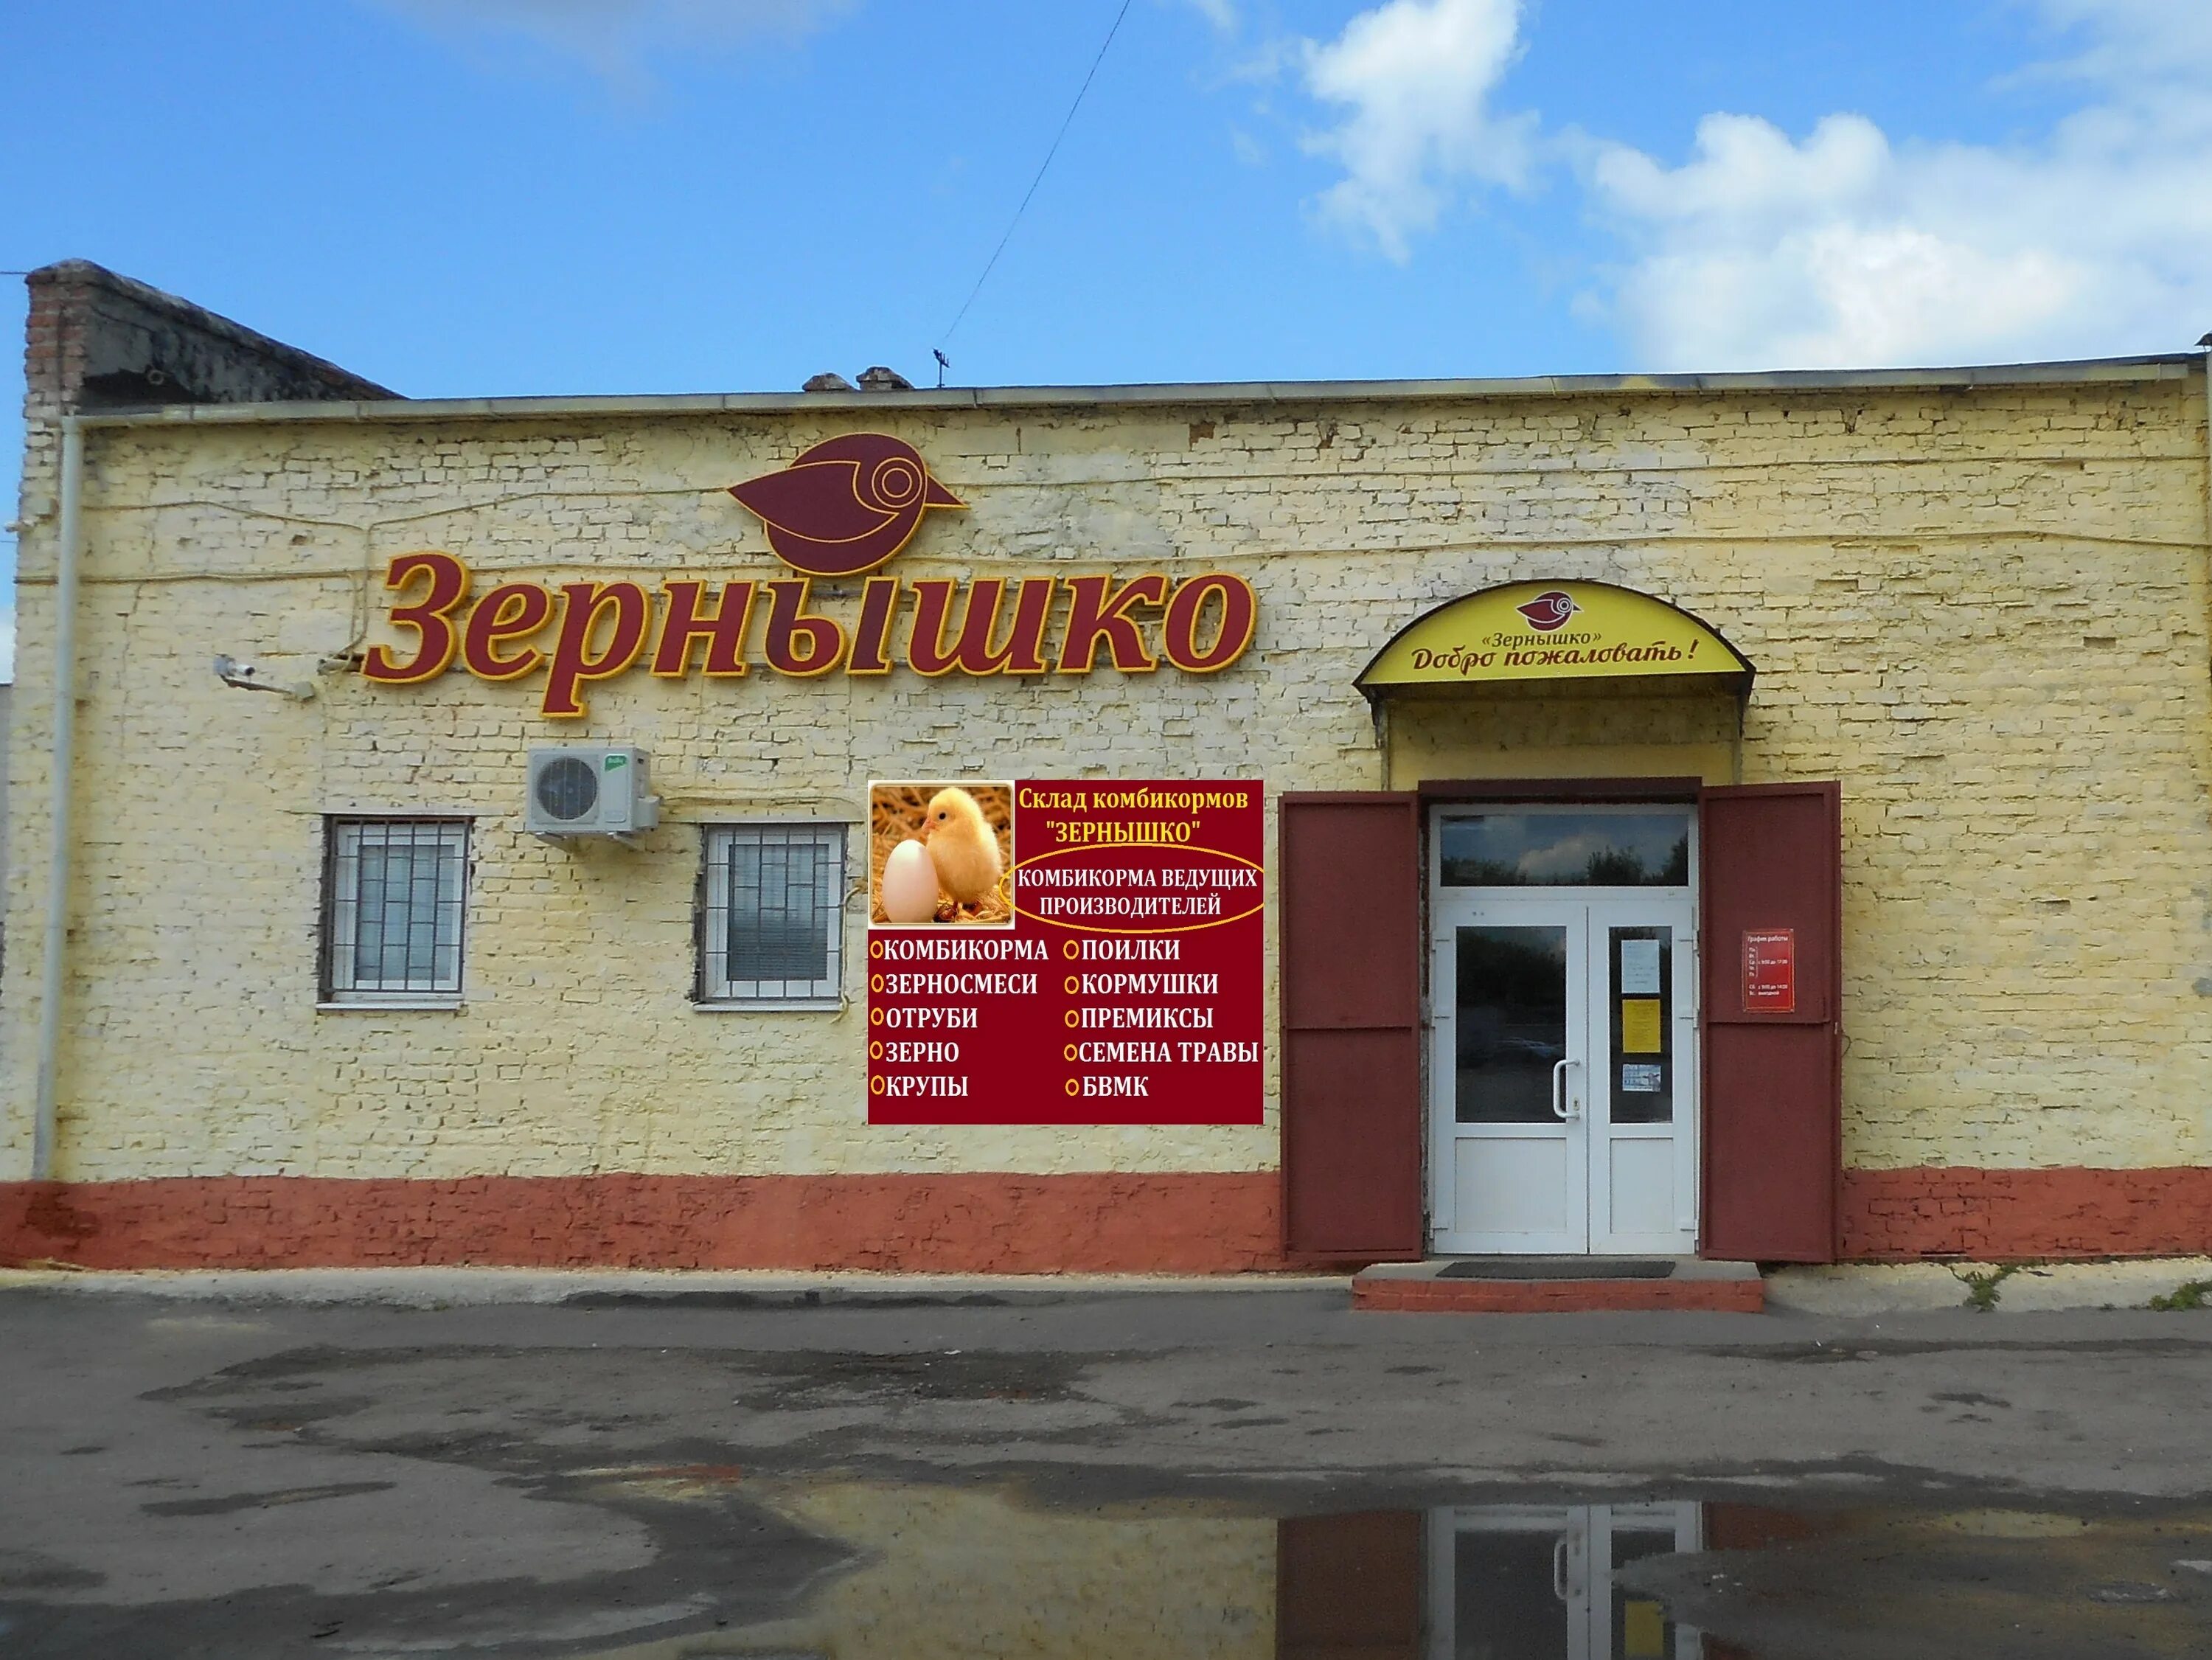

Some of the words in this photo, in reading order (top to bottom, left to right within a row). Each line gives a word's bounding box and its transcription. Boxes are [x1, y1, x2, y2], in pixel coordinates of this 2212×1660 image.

[361, 551, 1258, 719] Зернышко
[1411, 645, 1496, 676] Добро
[1019, 788, 1088, 813] Склад
[1093, 787, 1248, 813] комбикормов
[1046, 820, 1200, 843] "ЗЕРНЫШКО"
[1018, 869, 1157, 887] КОМБИКОРМА
[1161, 869, 1258, 889] ВЕДУЩИХ
[1040, 892, 1221, 919] ПРОИЗВОДИТЕЛЕЙ
[884, 940, 1049, 960] КОМБИКОРМА
[1082, 940, 1180, 960] ПОИЛКИ
[886, 973, 1037, 994] ЗЕРНОСМЕСИ
[1082, 973, 1219, 994] КОРМУШКИ
[886, 1007, 978, 1028] ОТРУБИ
[1081, 1007, 1214, 1028] ПРЕМИКСЫ
[886, 1041, 959, 1063] ЗЕРНО
[1079, 1041, 1172, 1063] СЕМЕНА
[1177, 1041, 1259, 1063] ТРАВЫ
[886, 1076, 969, 1097] КРУПЫ
[1082, 1076, 1149, 1097] БВМК
